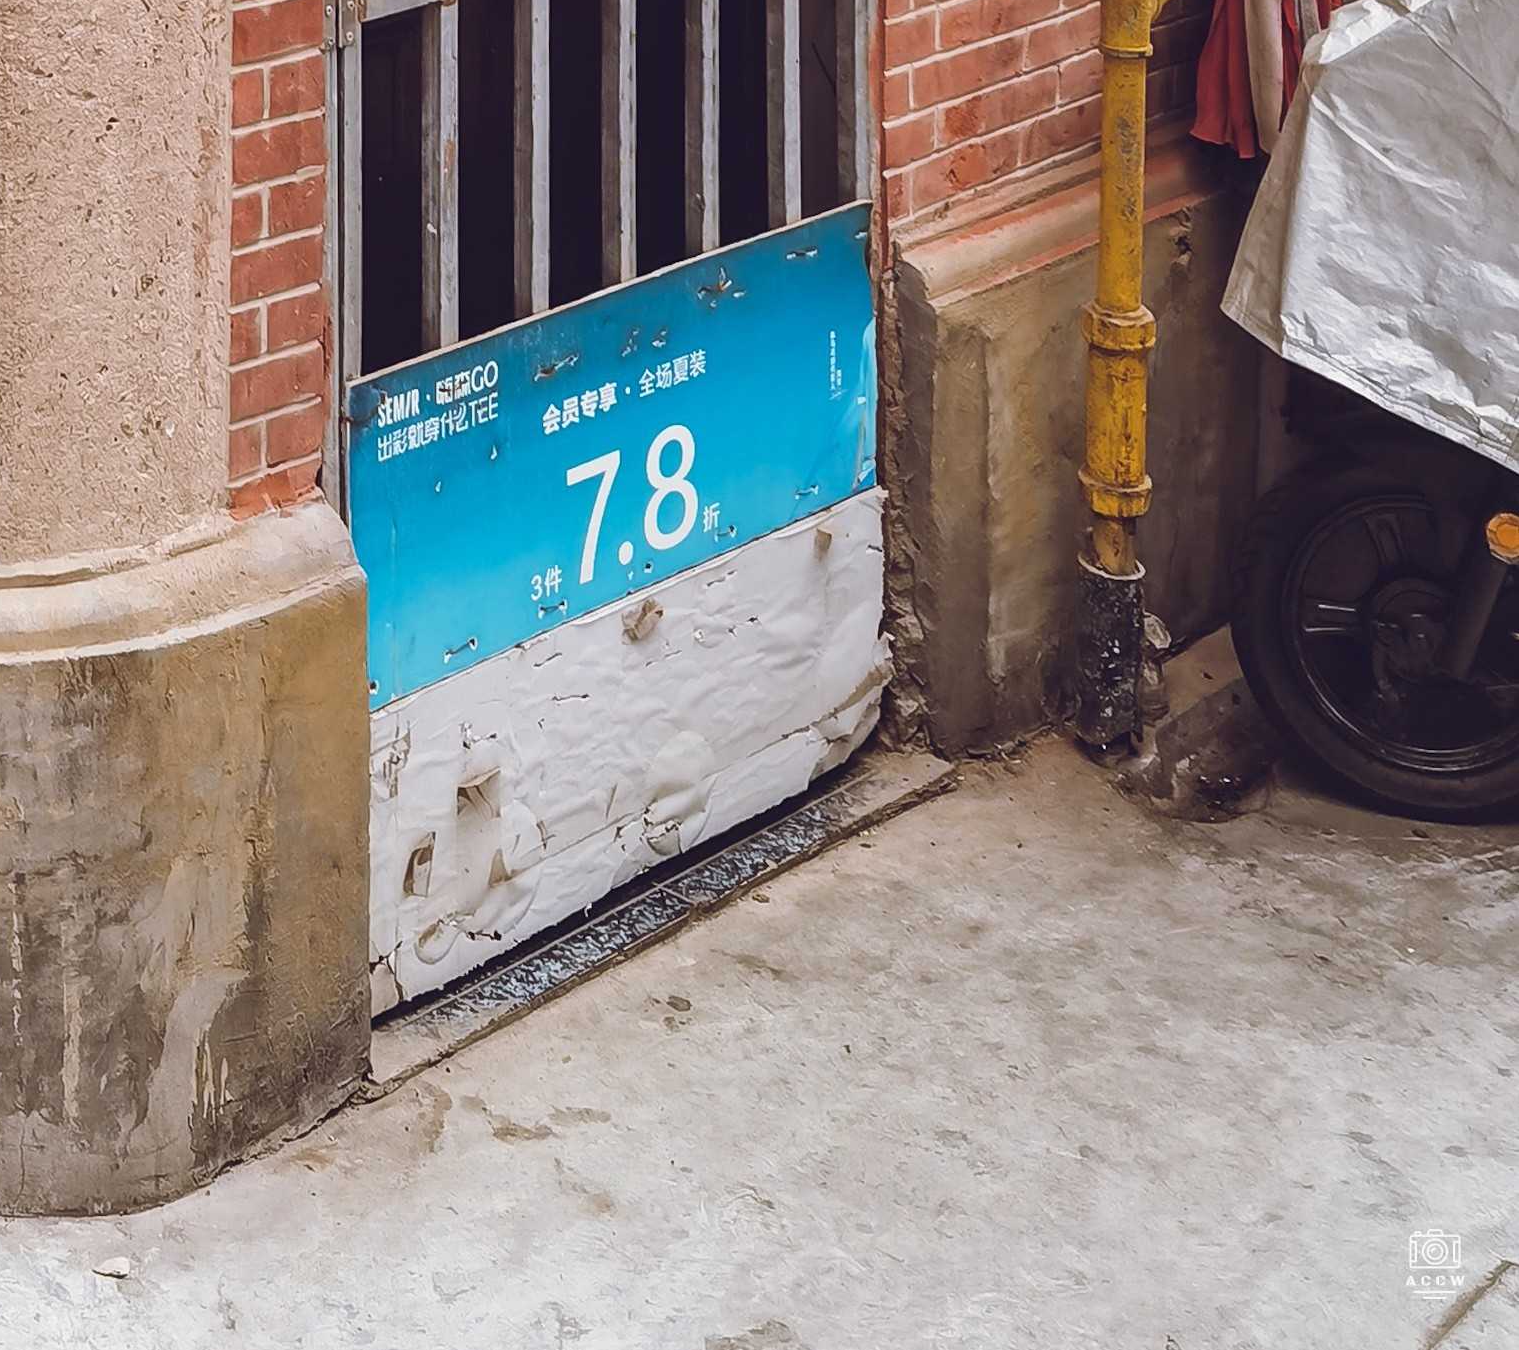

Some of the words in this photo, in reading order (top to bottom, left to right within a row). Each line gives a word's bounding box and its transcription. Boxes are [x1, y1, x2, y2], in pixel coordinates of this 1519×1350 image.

[530, 565, 563, 602] 3件
[565, 423, 700, 586] 7.8
[702, 502, 721, 533] 折
